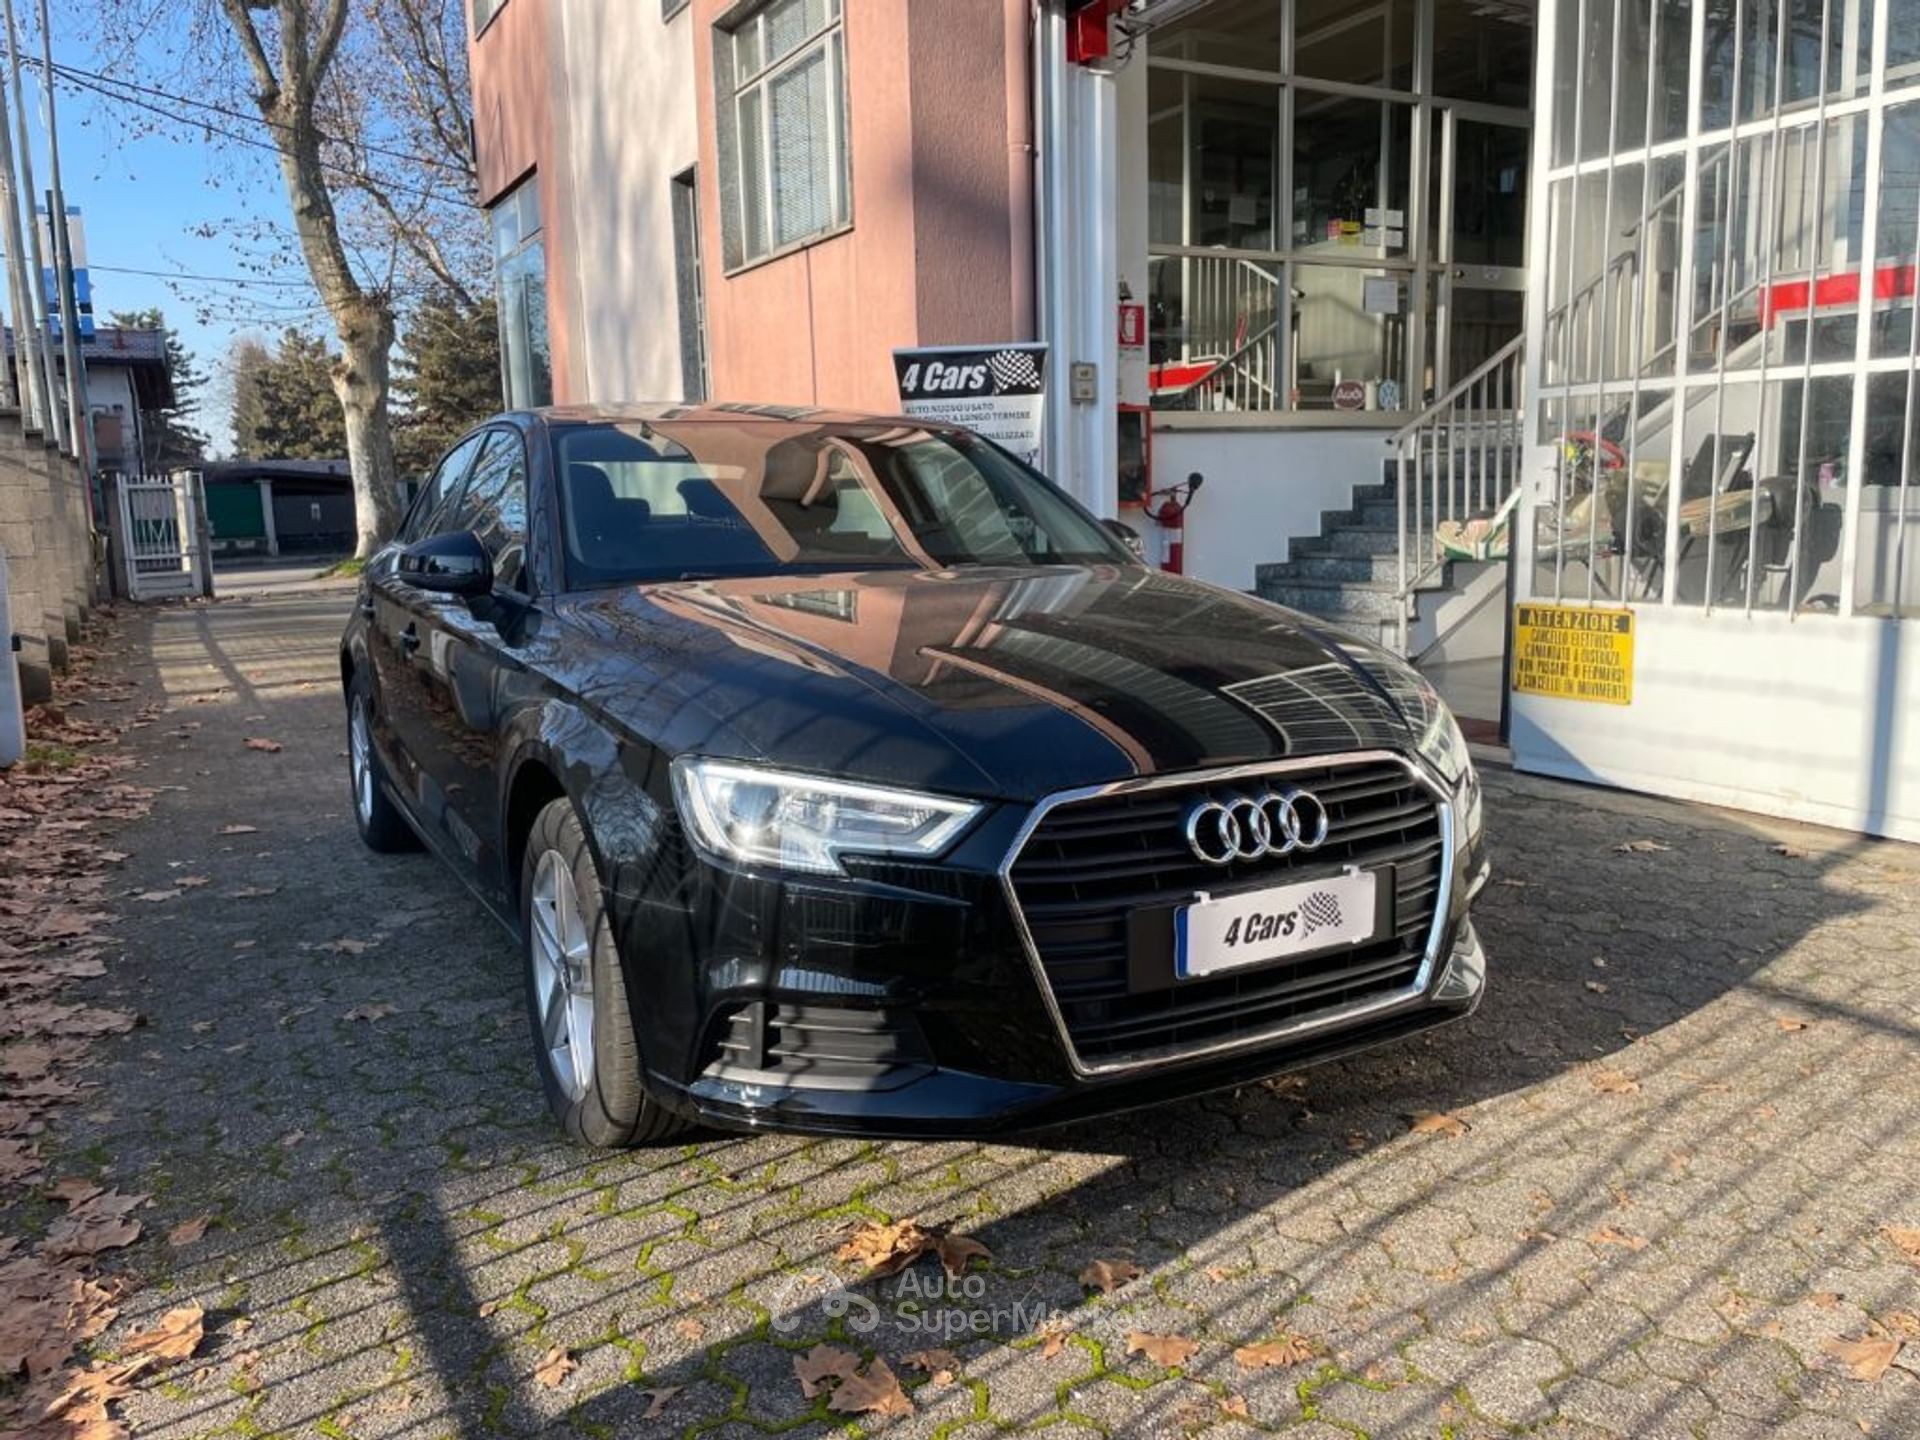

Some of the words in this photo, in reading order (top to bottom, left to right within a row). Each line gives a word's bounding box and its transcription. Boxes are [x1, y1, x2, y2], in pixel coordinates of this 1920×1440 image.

[902, 363, 920, 392] 4
[923, 362, 986, 391] Cars
[905, 406, 929, 414] AUTO
[993, 411, 1031, 420] TERMINE
[1527, 609, 1620, 632] ATTENZIONE
[1223, 917, 1242, 948] 4
[1244, 911, 1298, 944] Cars
